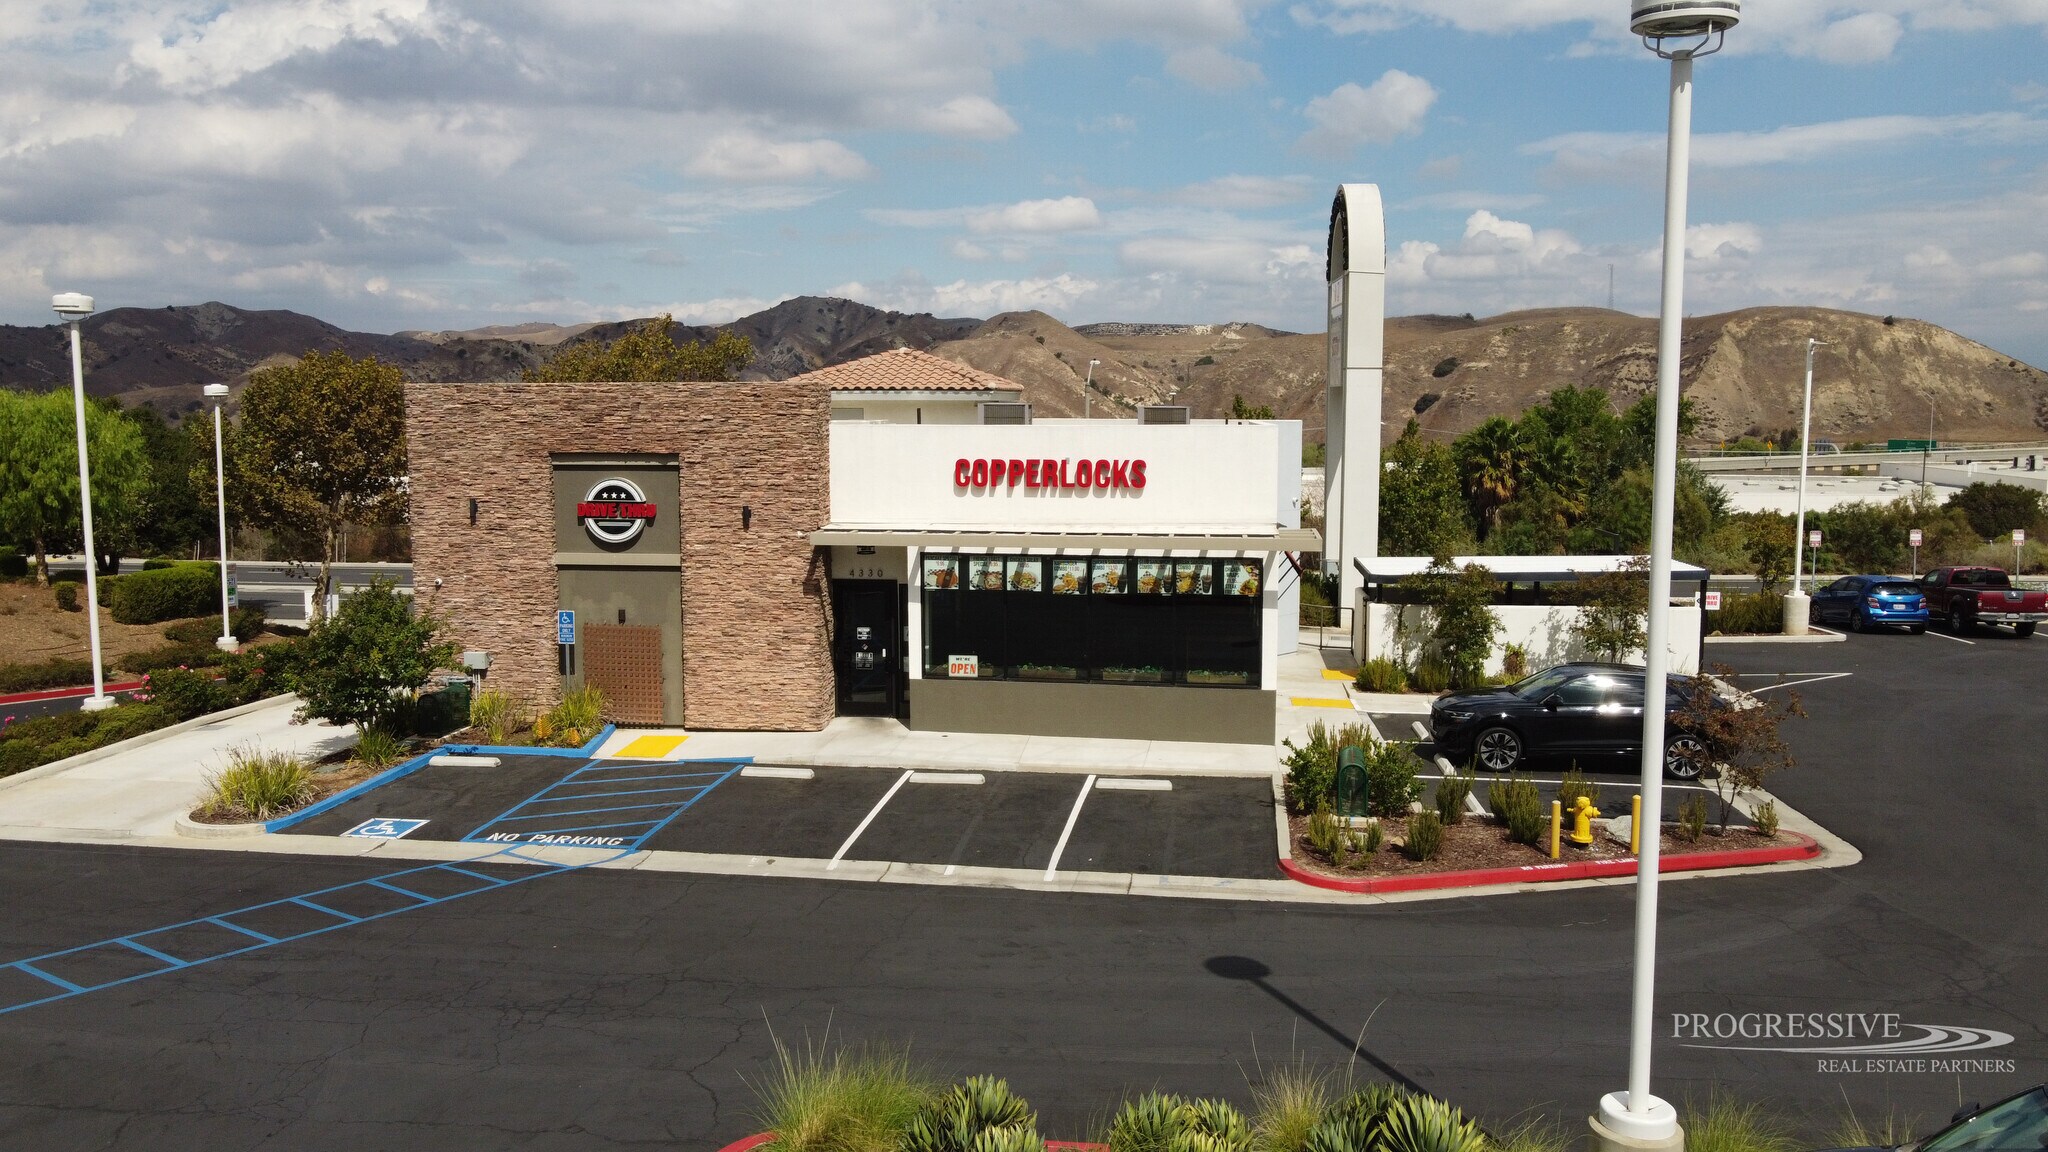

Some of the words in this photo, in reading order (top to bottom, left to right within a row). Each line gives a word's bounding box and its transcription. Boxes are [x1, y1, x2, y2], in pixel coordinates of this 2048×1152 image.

[955, 459, 1146, 488] COPPERLOCKS
[577, 503, 618, 518] DRIVE
[620, 503, 657, 518] THRU
[850, 569, 883, 578] 4330
[951, 664, 976, 674] OPEN
[486, 832, 520, 842] NO
[528, 834, 624, 846] PARKING
